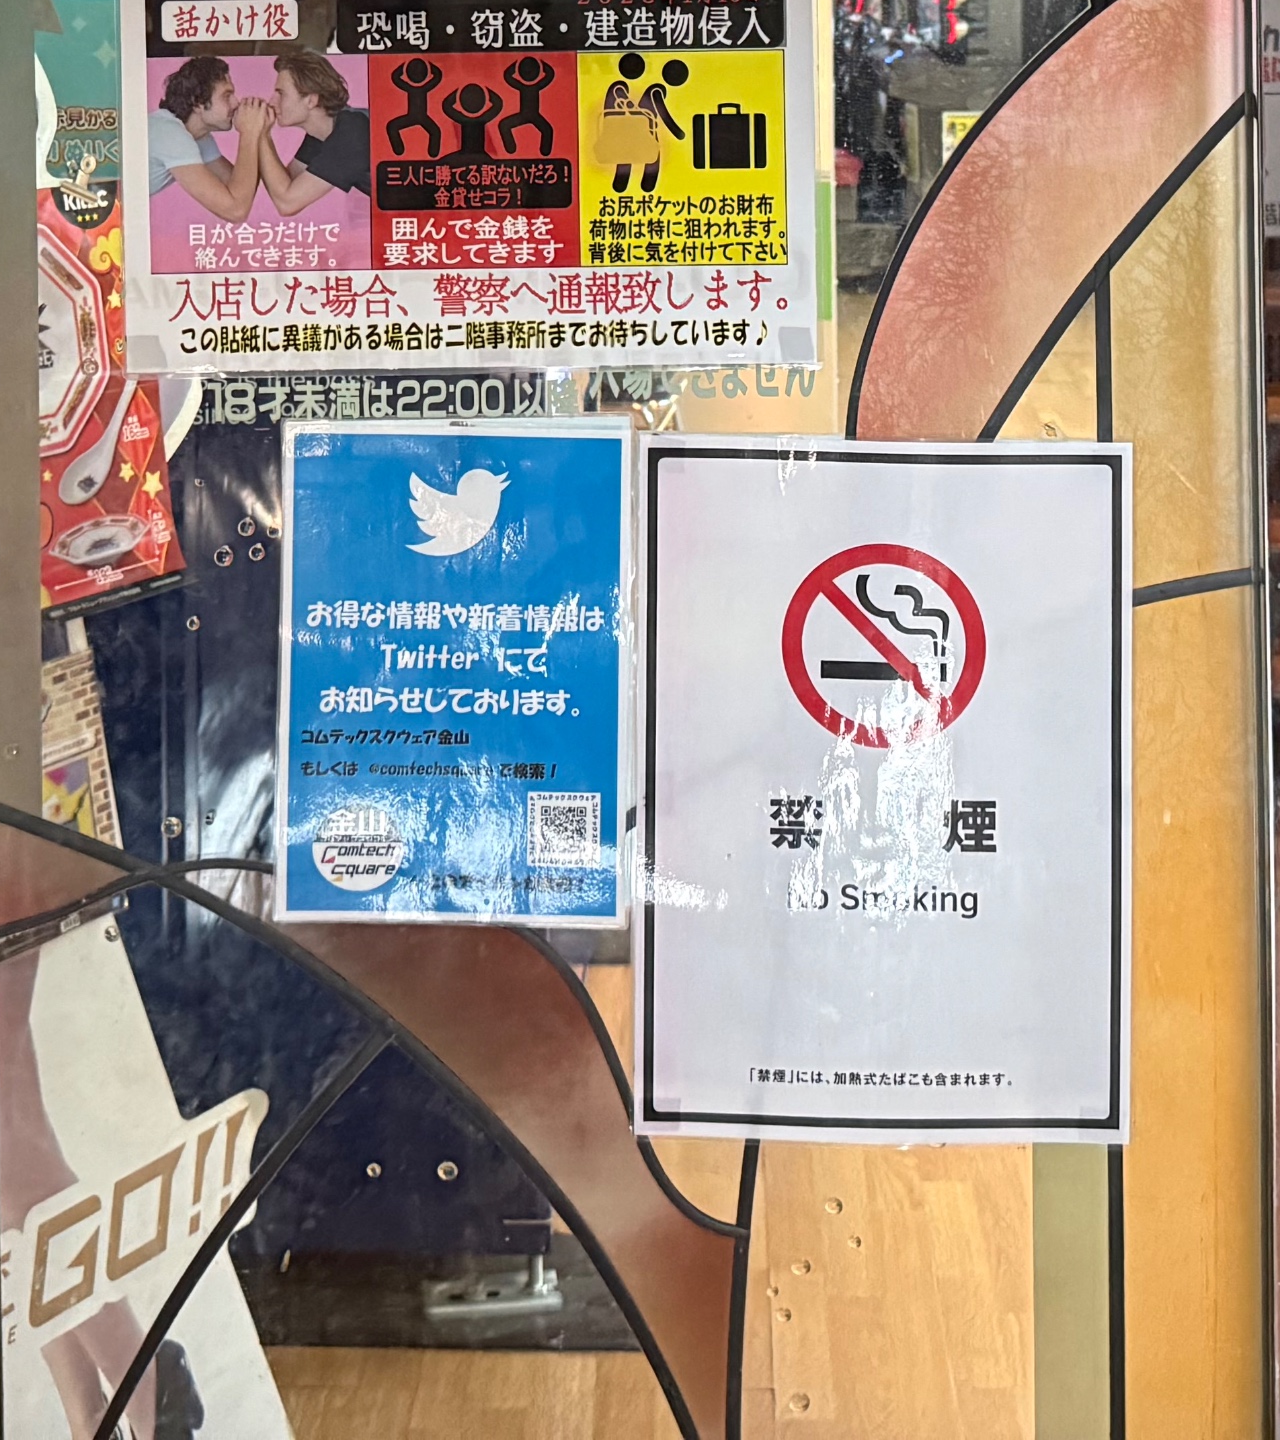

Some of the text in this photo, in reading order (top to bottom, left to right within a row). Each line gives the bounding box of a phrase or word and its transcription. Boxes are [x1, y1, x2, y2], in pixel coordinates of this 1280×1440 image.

[172, 6, 292, 39] 話かけ役
[357, 9, 771, 51] 恐喝・窃盗・建造物侵入
[599, 194, 773, 216] お尻ポケットのお財布
[188, 221, 340, 246] 目が合うだけで
[392, 215, 553, 241] 囲んで金銭を
[590, 218, 786, 240] 荷物は特に狙われます。
[194, 246, 340, 270] 絡んできます。
[383, 241, 564, 266] 要求してきます
[589, 242, 787, 263] 背後に気を付けて下さい
[168, 271, 788, 321] 入店した場合、警察へ通報致します。
[307, 600, 605, 633] お得な情報や新着情報は
[381, 643, 548, 673] Twitter にて
[319, 686, 581, 717] お知らせしております。
[301, 729, 470, 745] コムテックスクウェア金山
[301, 762, 358, 777] もしくは
[328, 809, 388, 835] 金山
[749, 1068, 1012, 1087] 「禁煙」には、加熱式たばこも含まれます。
